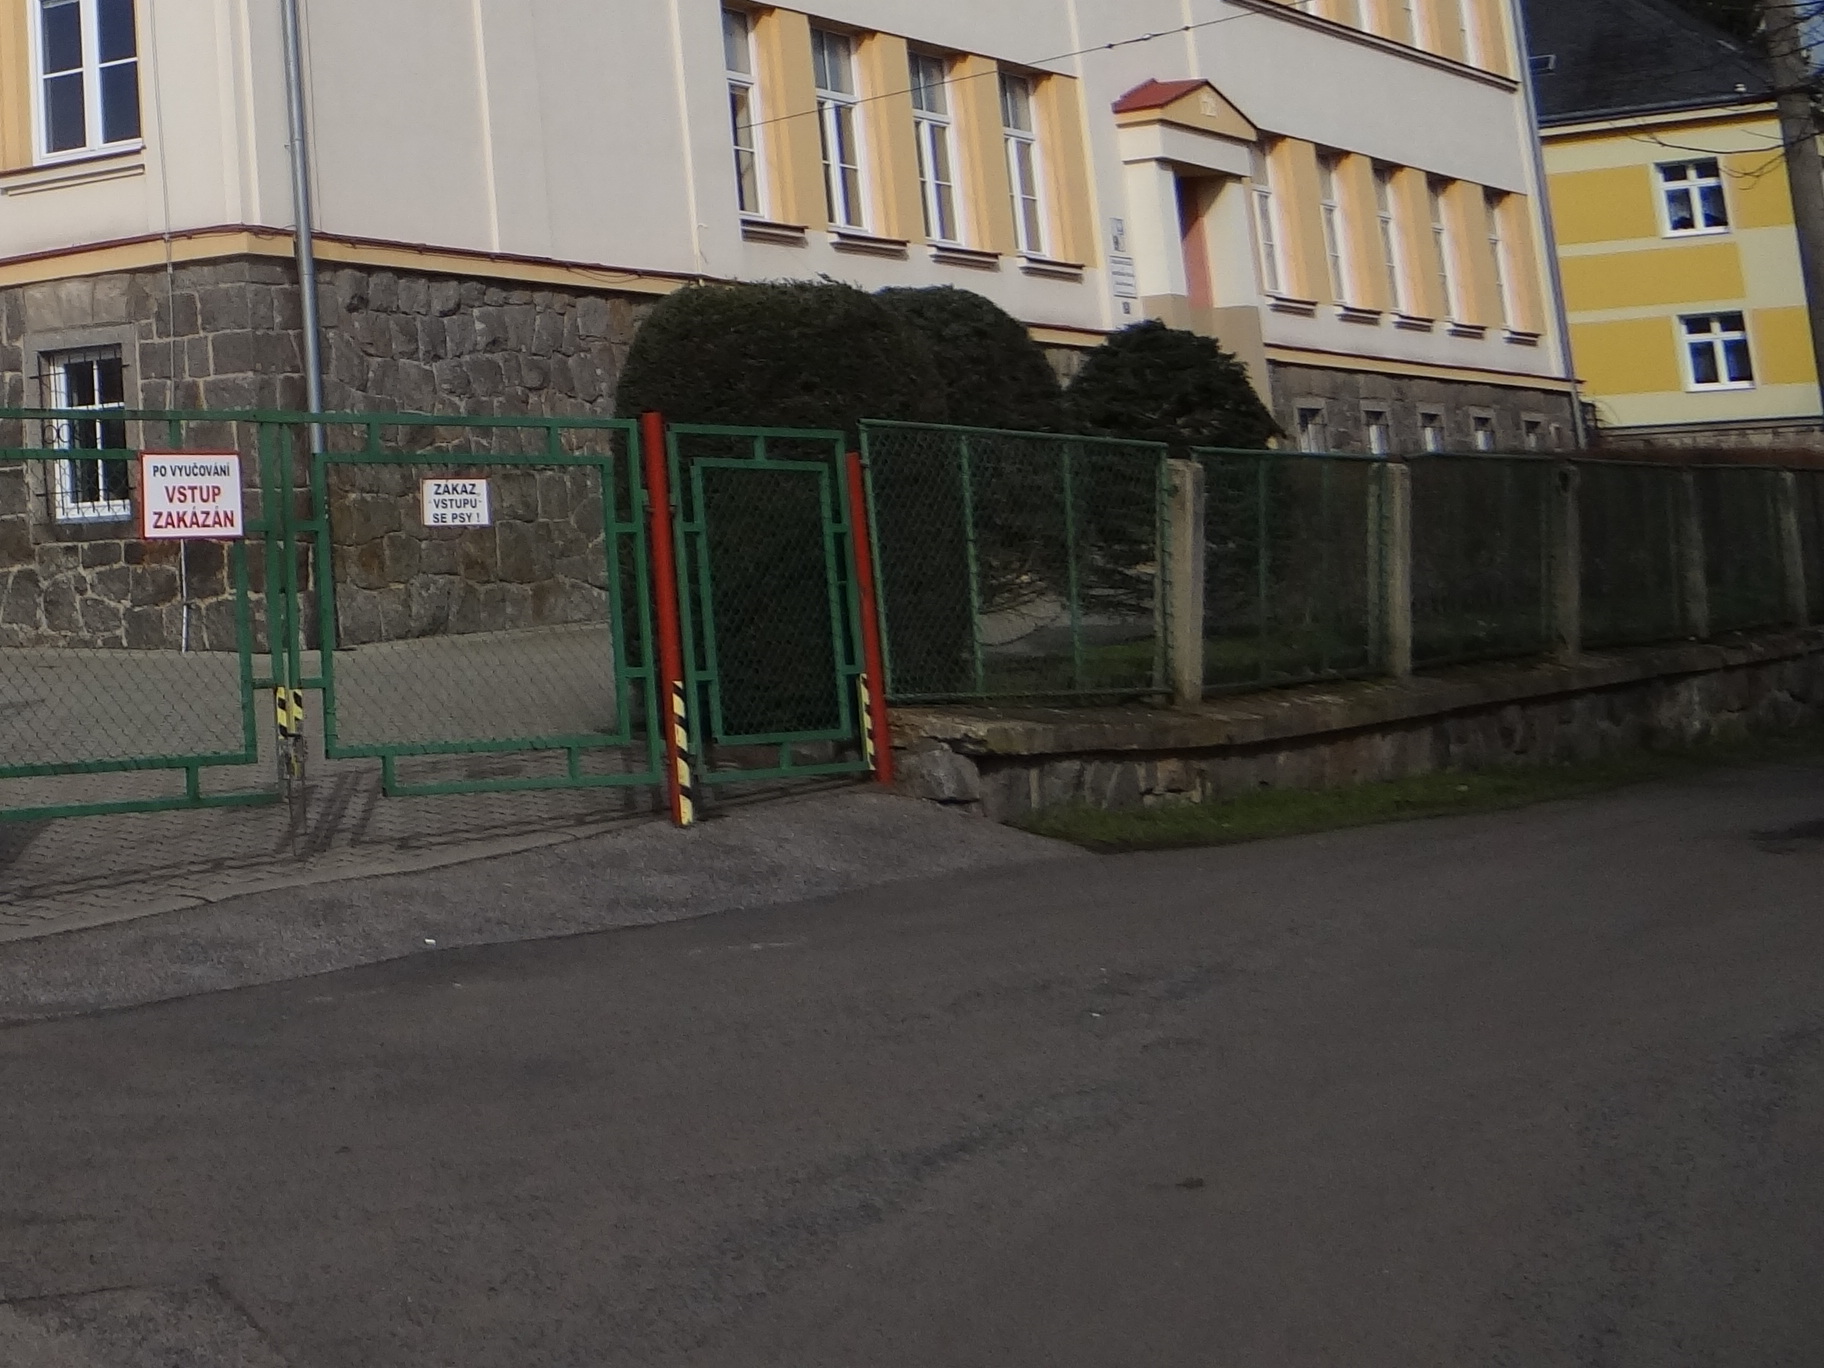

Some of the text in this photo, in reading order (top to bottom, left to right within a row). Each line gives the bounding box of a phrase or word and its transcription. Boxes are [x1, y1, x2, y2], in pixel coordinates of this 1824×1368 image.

[152, 463, 230, 477] PO VYUČOVÁNÍ
[164, 485, 221, 504] VSTUP
[433, 498, 477, 509] VSTUPU
[152, 506, 234, 529] ZAKÁZÁN
[433, 513, 447, 523] SE
[451, 512, 472, 523] PSY
